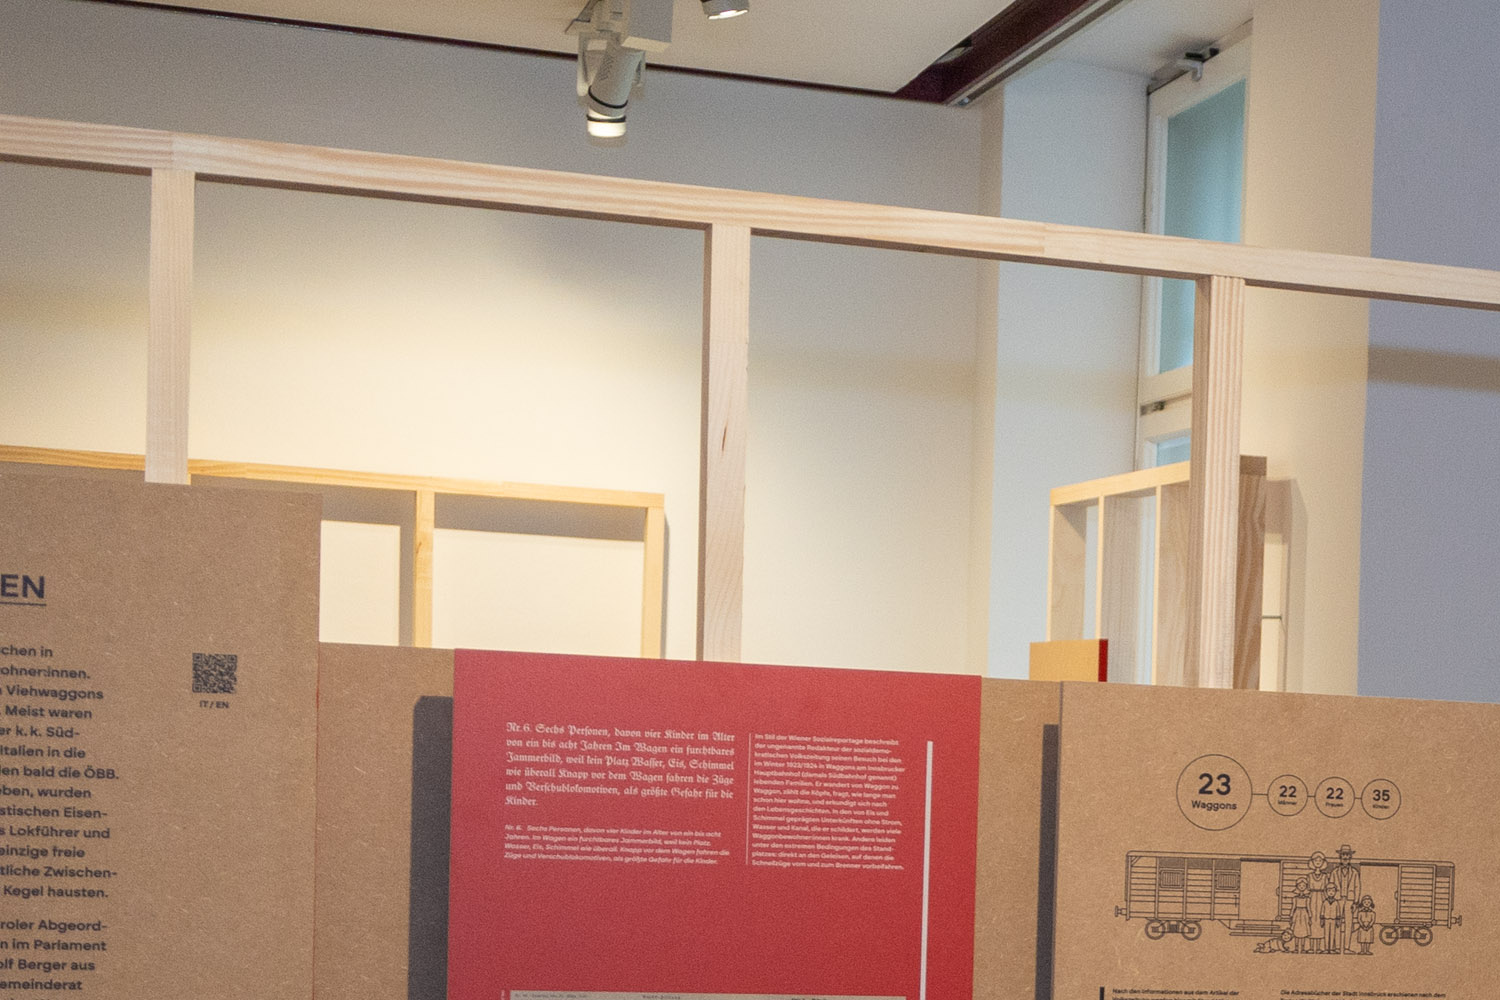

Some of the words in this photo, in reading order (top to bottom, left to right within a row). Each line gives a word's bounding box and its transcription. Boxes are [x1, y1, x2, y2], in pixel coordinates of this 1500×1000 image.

[40, 645, 53, 657] in
[6, 684, 104, 701] Viehwaggons
[4, 704, 45, 717] Meist
[48, 709, 92, 719] waren
[15, 724, 27, 736] k.
[29, 725, 42, 737] k.
[46, 726, 79, 738] Süd-
[47, 745, 60, 757] in
[63, 746, 86, 758] die
[22, 765, 55, 778] bald
[57, 766, 81, 778] die
[83, 765, 119, 779] ÖBB.
[36, 786, 91, 798] wurden
[1199, 772, 1232, 796] 23
[1279, 786, 1297, 798] 22
[1326, 787, 1344, 800] 22
[1372, 789, 1390, 801] 35
[63, 806, 107, 818] Eisen-
[1191, 800, 1238, 812] Waggons
[9, 825, 80, 837] Lokführer
[82, 827, 110, 839] und
[52, 845, 85, 858] freie
[43, 865, 117, 878] Zwischen-
[3, 885, 44, 899] Kegel
[47, 886, 108, 898] hausten.
[37, 919, 106, 933] Abgeord-
[12, 938, 30, 950] im
[33, 939, 106, 951] Parlament
[17, 958, 67, 973] Berger
[70, 961, 95, 971] aus
